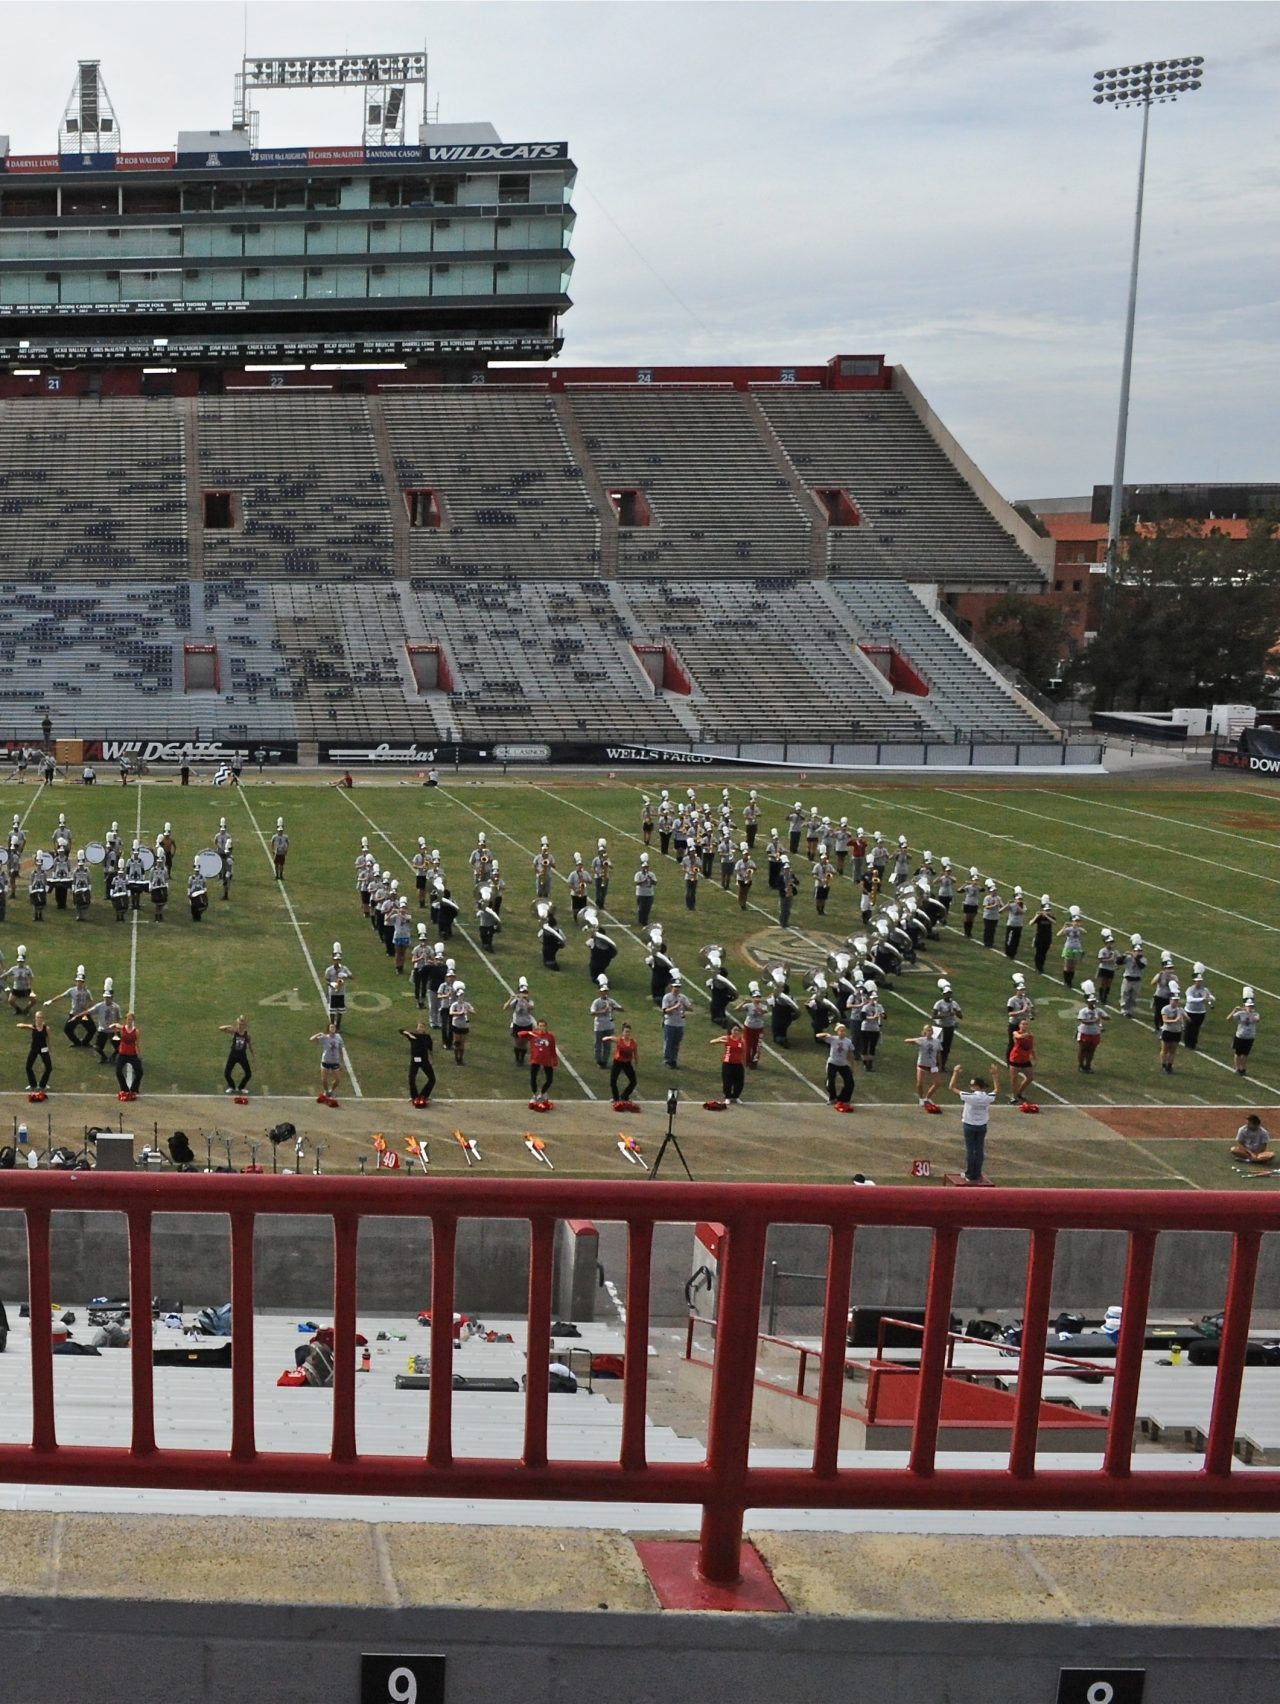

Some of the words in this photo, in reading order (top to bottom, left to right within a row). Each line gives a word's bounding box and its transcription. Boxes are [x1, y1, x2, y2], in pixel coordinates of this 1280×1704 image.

[260, 153, 274, 161] STEVE
[332, 151, 364, 159] McALISTER
[371, 150, 397, 158] ANTOINE
[398, 149, 420, 157] CASON
[429, 144, 560, 160] WILDCATS
[11, 160, 38, 168] DARRYLL
[39, 159, 59, 167] LEWIS
[125, 157, 138, 165] ROB
[139, 156, 170, 164] WALDROP
[271, 377, 284, 387] 22
[471, 374, 485, 384] 23
[638, 373, 651, 383] 24
[780, 373, 795, 383] 25
[47, 380, 60, 390] 21
[606, 748, 659, 760] WELLS
[258, 988, 393, 1012] 40
[383, 1151, 396, 1167] 40
[915, 1161, 930, 1176] 30
[388, 1667, 418, 1704] 9
